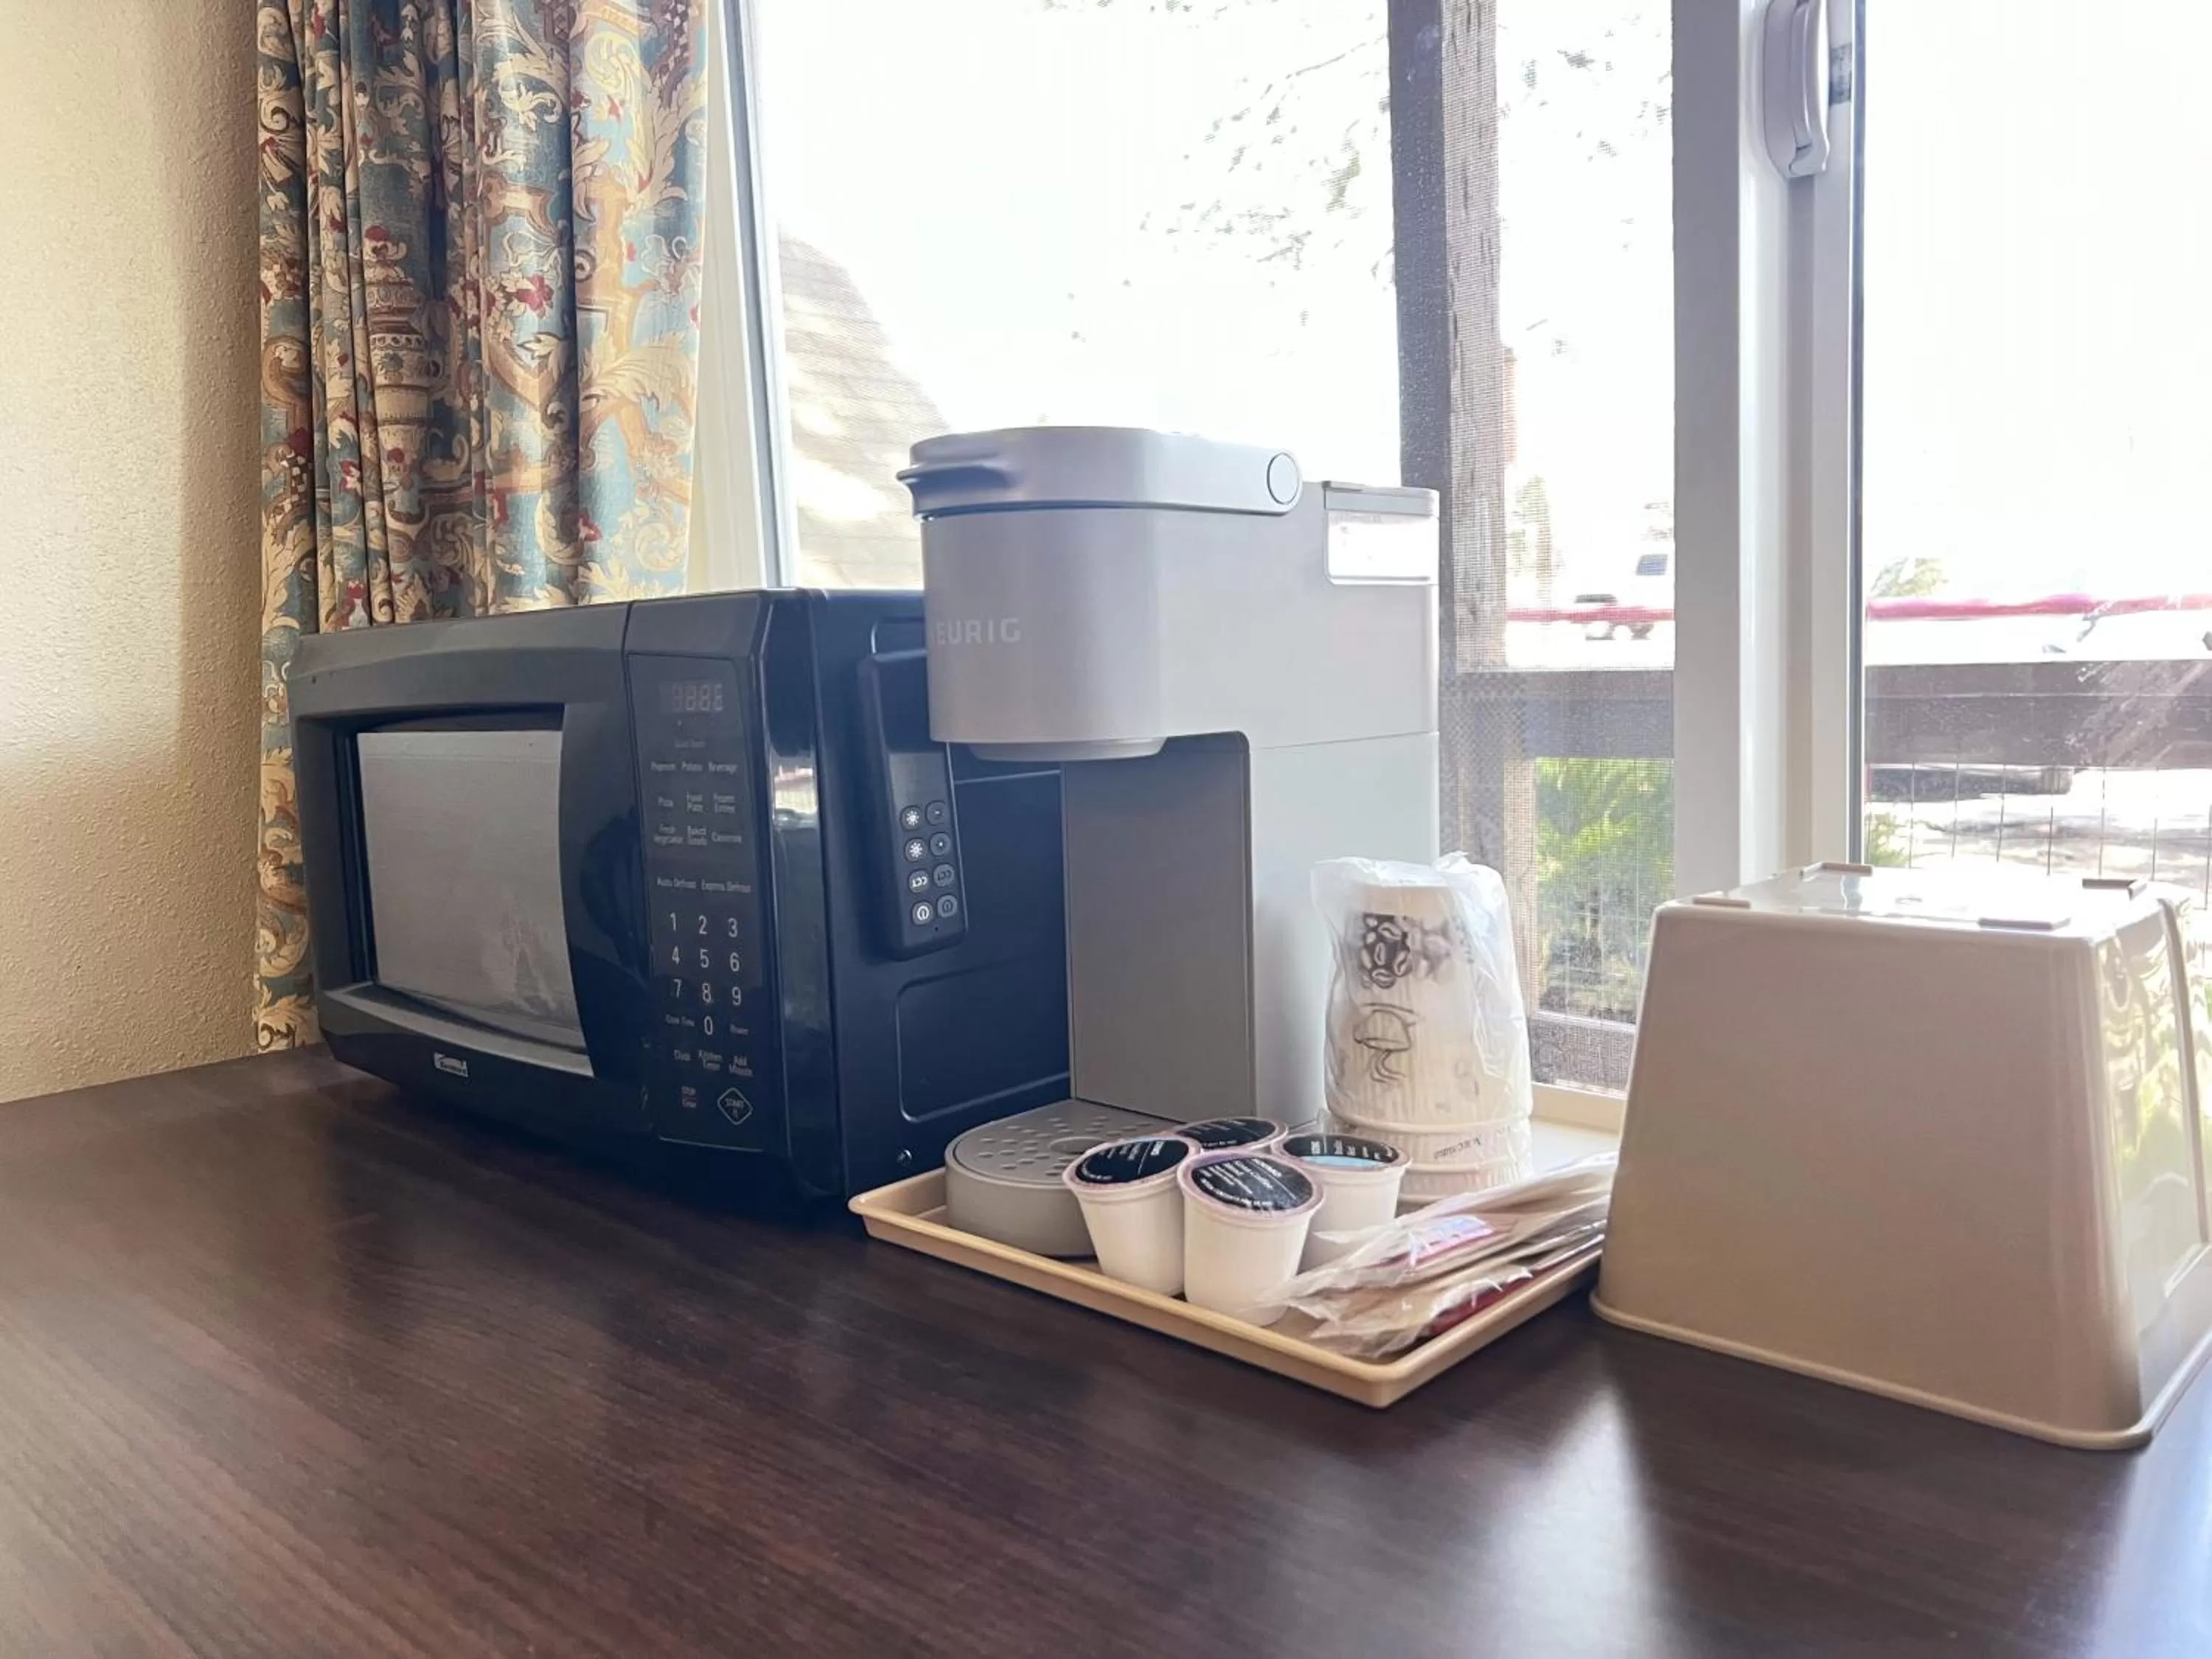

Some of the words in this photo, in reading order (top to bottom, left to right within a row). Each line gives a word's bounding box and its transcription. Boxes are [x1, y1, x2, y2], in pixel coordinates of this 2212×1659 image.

[932, 617, 1021, 645] EURIG
[669, 912, 677, 932] 1
[698, 915, 708, 935] 2
[728, 917, 738, 938] 3
[672, 946, 680, 966] 4
[700, 949, 709, 968] 5
[730, 952, 740, 972] 6
[674, 979, 682, 998] 7
[701, 983, 712, 1004] 8
[732, 986, 742, 1006] 9
[703, 1015, 714, 1036] 0
